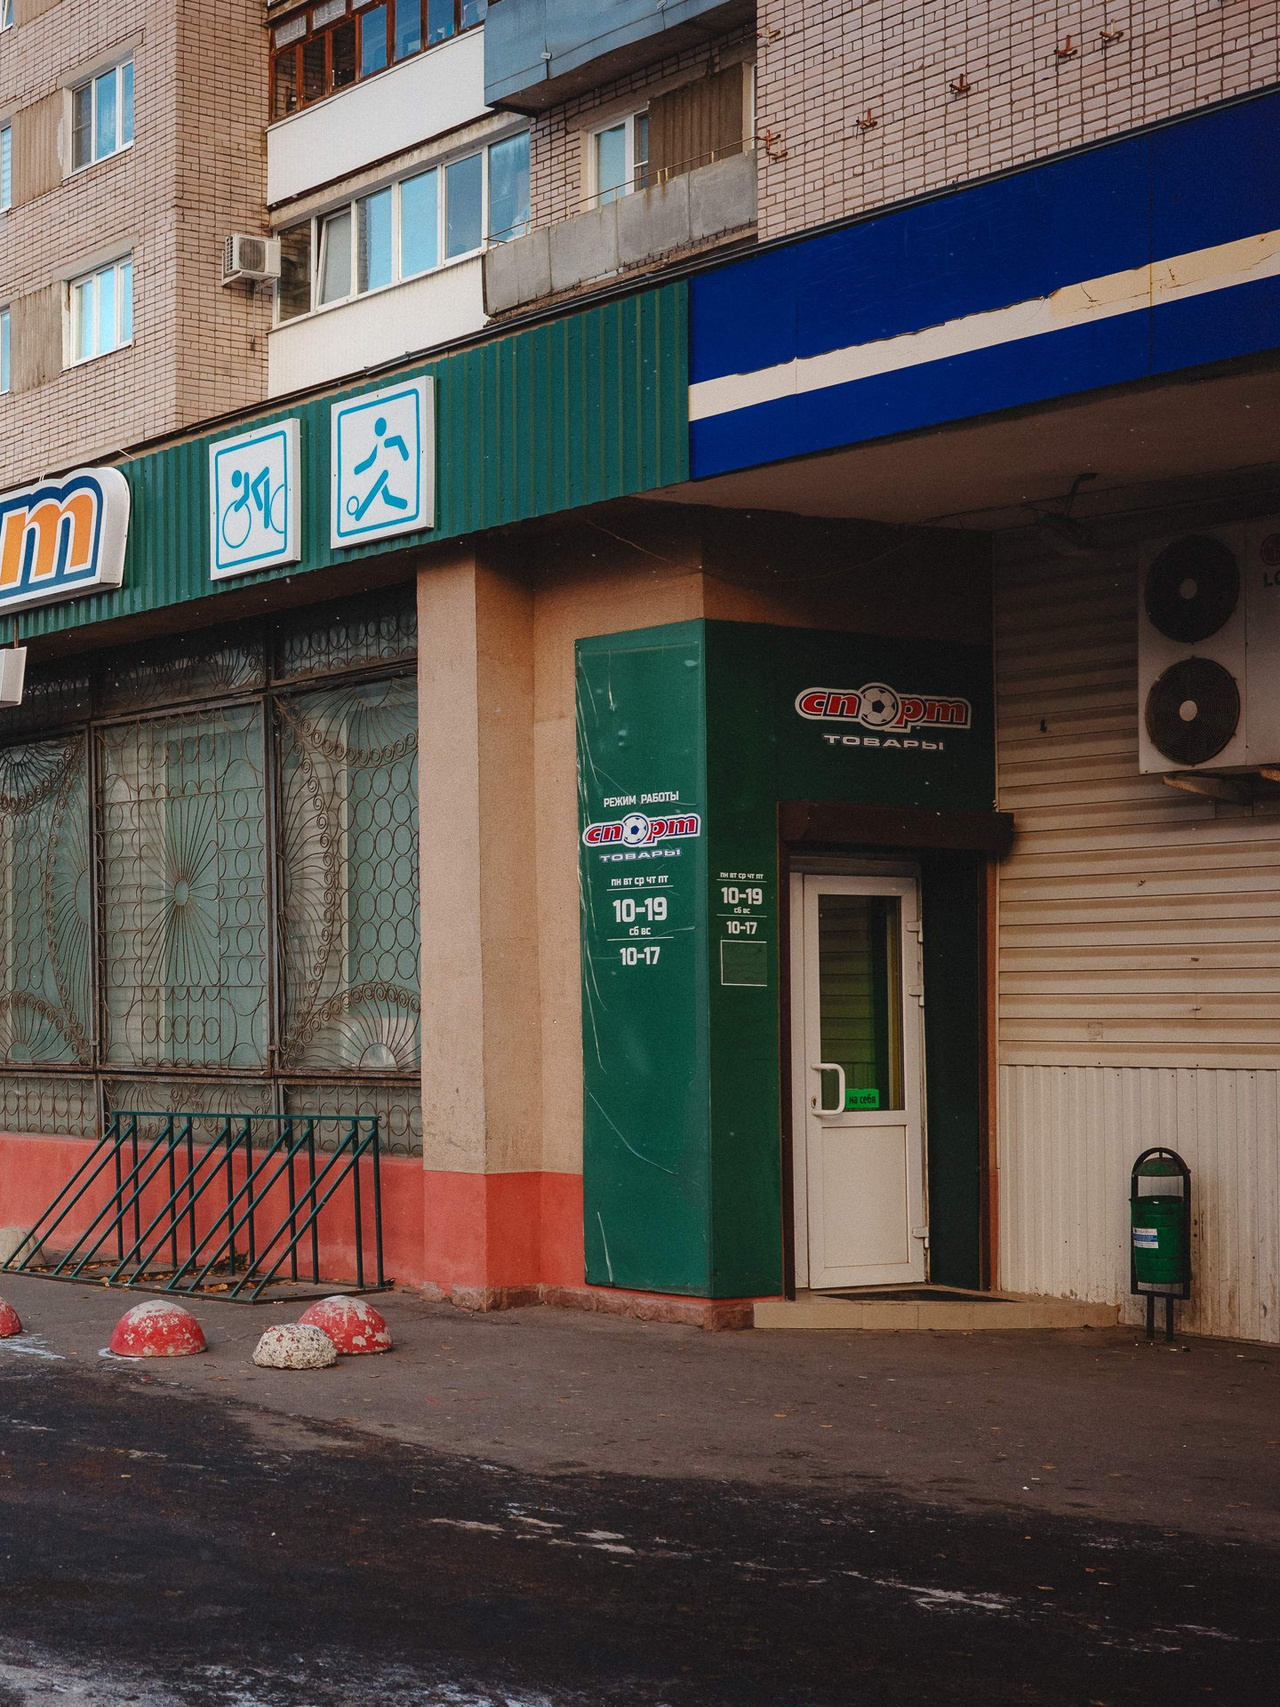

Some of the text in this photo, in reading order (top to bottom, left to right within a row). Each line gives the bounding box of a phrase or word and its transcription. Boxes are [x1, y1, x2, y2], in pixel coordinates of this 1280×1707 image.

[824, 735, 944, 750] ТОВАРЫ
[603, 791, 679, 808] РЕЖИМ РАБОТЫ
[600, 849, 681, 862] ТОВАРЫ
[611, 878, 622, 886] пн
[623, 877, 633, 885] вт
[634, 877, 645, 886] ср
[658, 875, 669, 883] пт
[721, 886, 763, 905] 10-19
[612, 896, 668, 923] 10-19
[629, 926, 651, 936] сб вс
[726, 921, 758, 935] 10-17
[620, 946, 661, 966] 10-17
[849, 1093, 876, 1104] на себя
